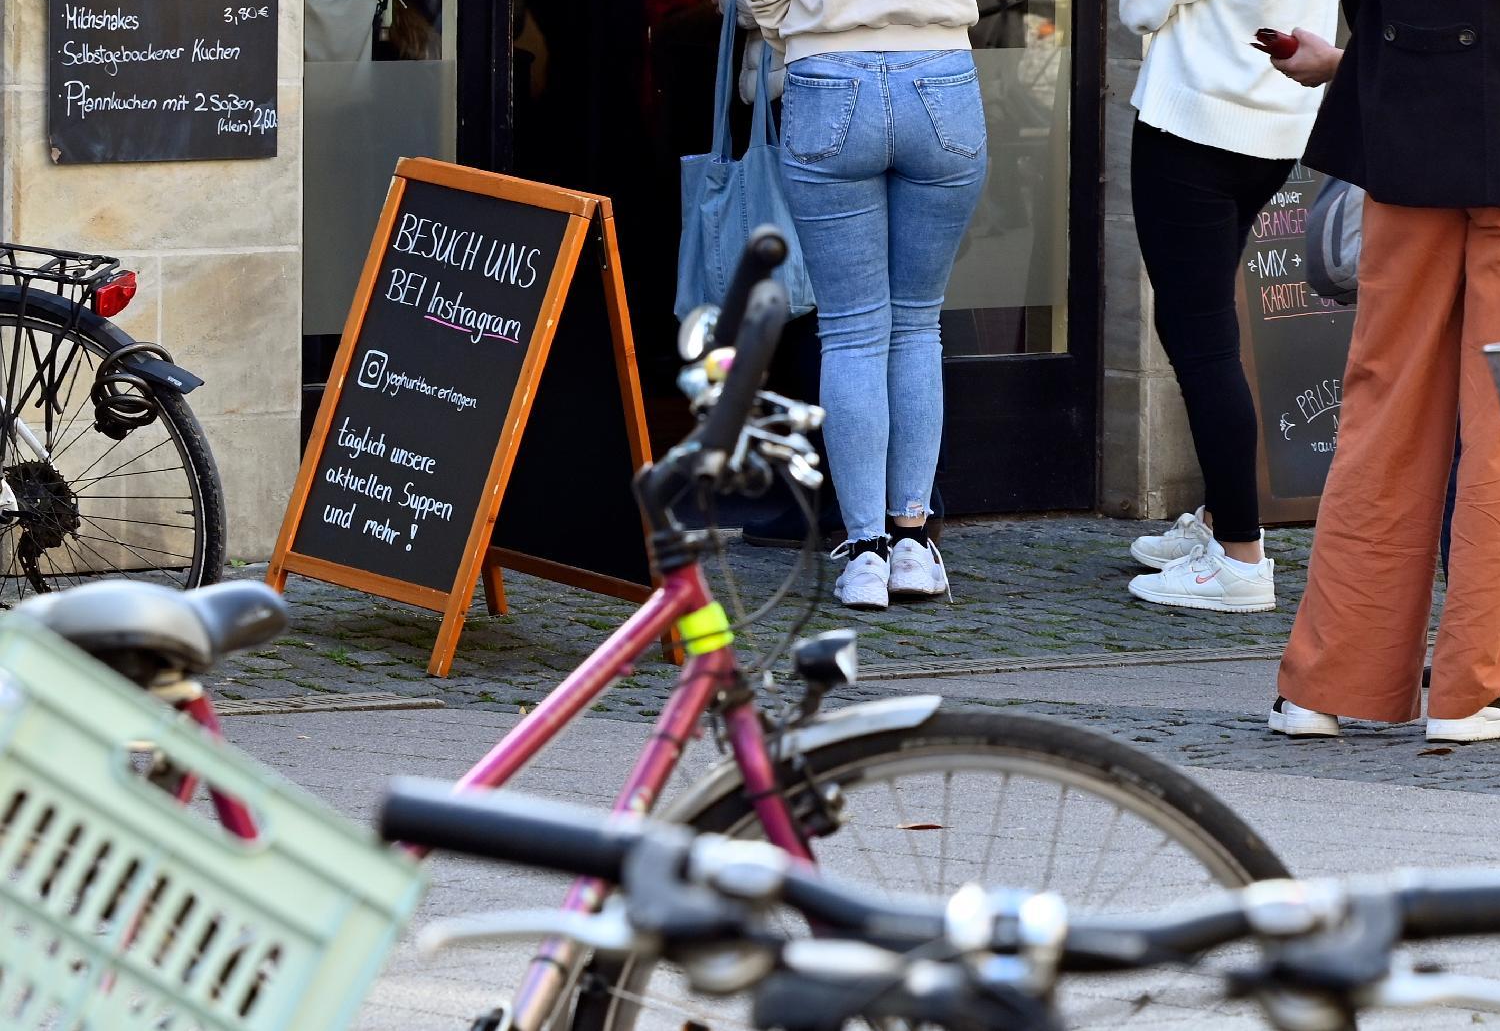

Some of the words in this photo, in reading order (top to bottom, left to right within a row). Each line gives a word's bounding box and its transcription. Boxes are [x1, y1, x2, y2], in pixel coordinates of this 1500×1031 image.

[64, 3, 140, 31] Milchshakes
[223, 6, 269, 26] 3,80€
[61, 40, 185, 77] Selbstgebackener
[191, 38, 241, 62] Kuchen
[63, 80, 157, 119] Pfannkuchen
[162, 94, 190, 112] mit
[195, 92, 208, 111] 2
[209, 93, 254, 119] Soßen
[217, 117, 252, 136] (klein)
[393, 212, 484, 271] BESUCH
[484, 239, 541, 288] UNS
[1257, 248, 1288, 279] MIX
[385, 268, 427, 307] BEI
[427, 281, 521, 344] Instragram
[1261, 281, 1308, 315] KAROTTE
[381, 370, 477, 412] yoghurtbar.erlangen
[337, 416, 386, 459] täglich
[390, 446, 436, 474] unsere
[325, 466, 393, 503] aktuellen
[398, 481, 453, 522] Suppen
[323, 503, 356, 530] und
[363, 518, 400, 545] mehr
[405, 523, 418, 551] !
